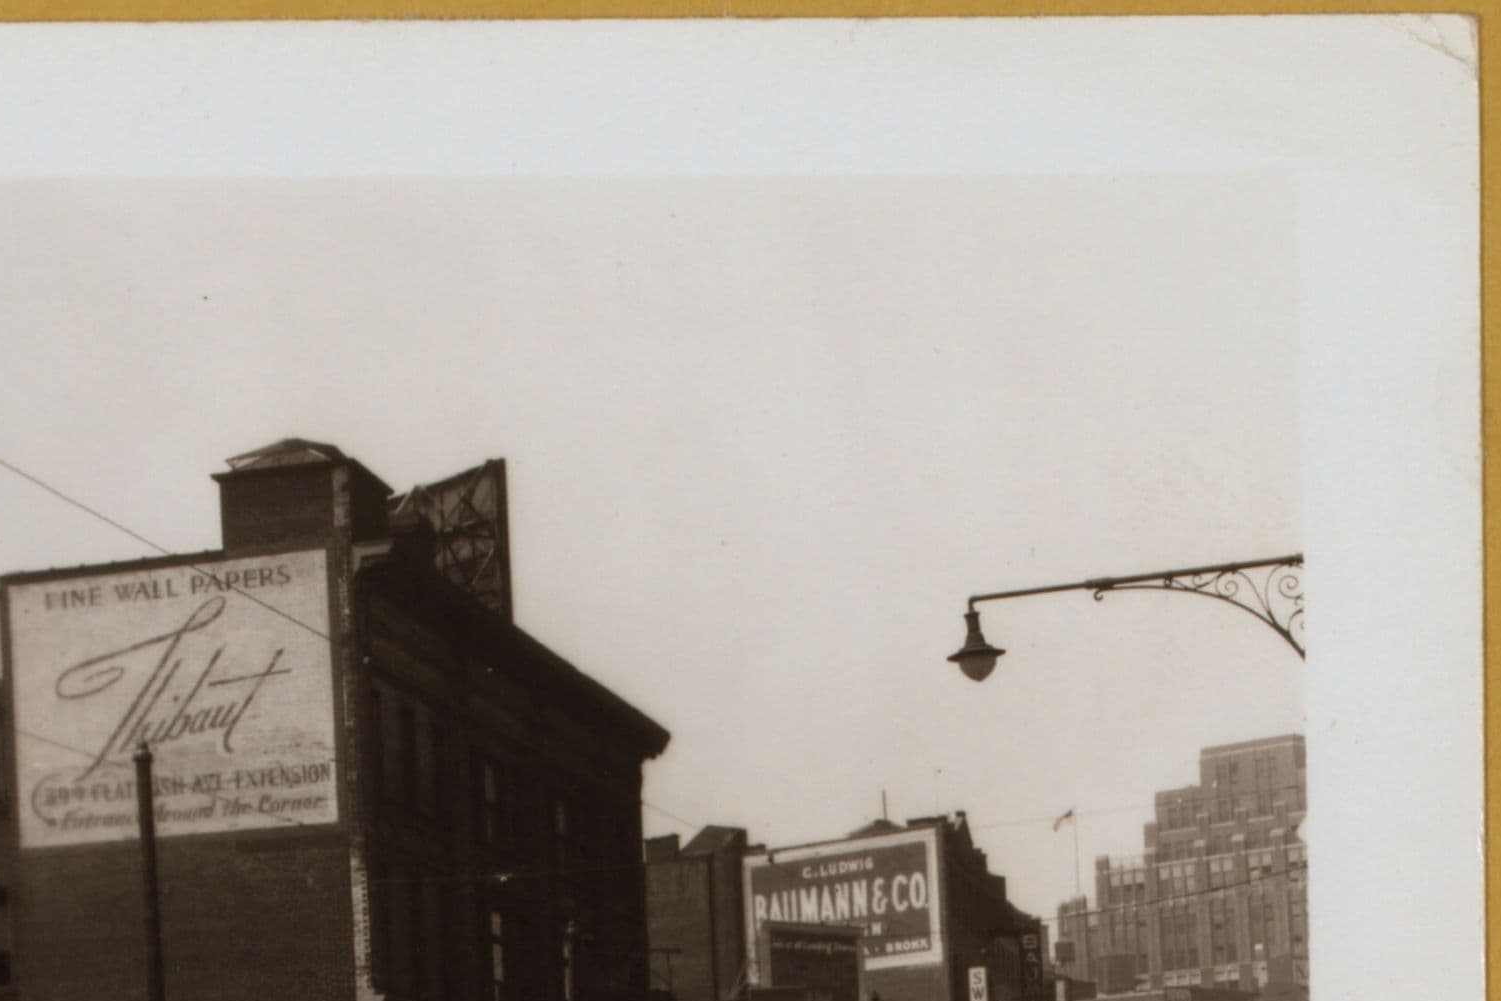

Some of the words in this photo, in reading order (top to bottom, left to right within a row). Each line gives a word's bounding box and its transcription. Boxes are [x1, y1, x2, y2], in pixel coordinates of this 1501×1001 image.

[45, 586, 102, 610] FINE
[114, 578, 180, 602] WALL
[190, 567, 292, 594] PAPERS
[56, 596, 293, 784] Thibaut
